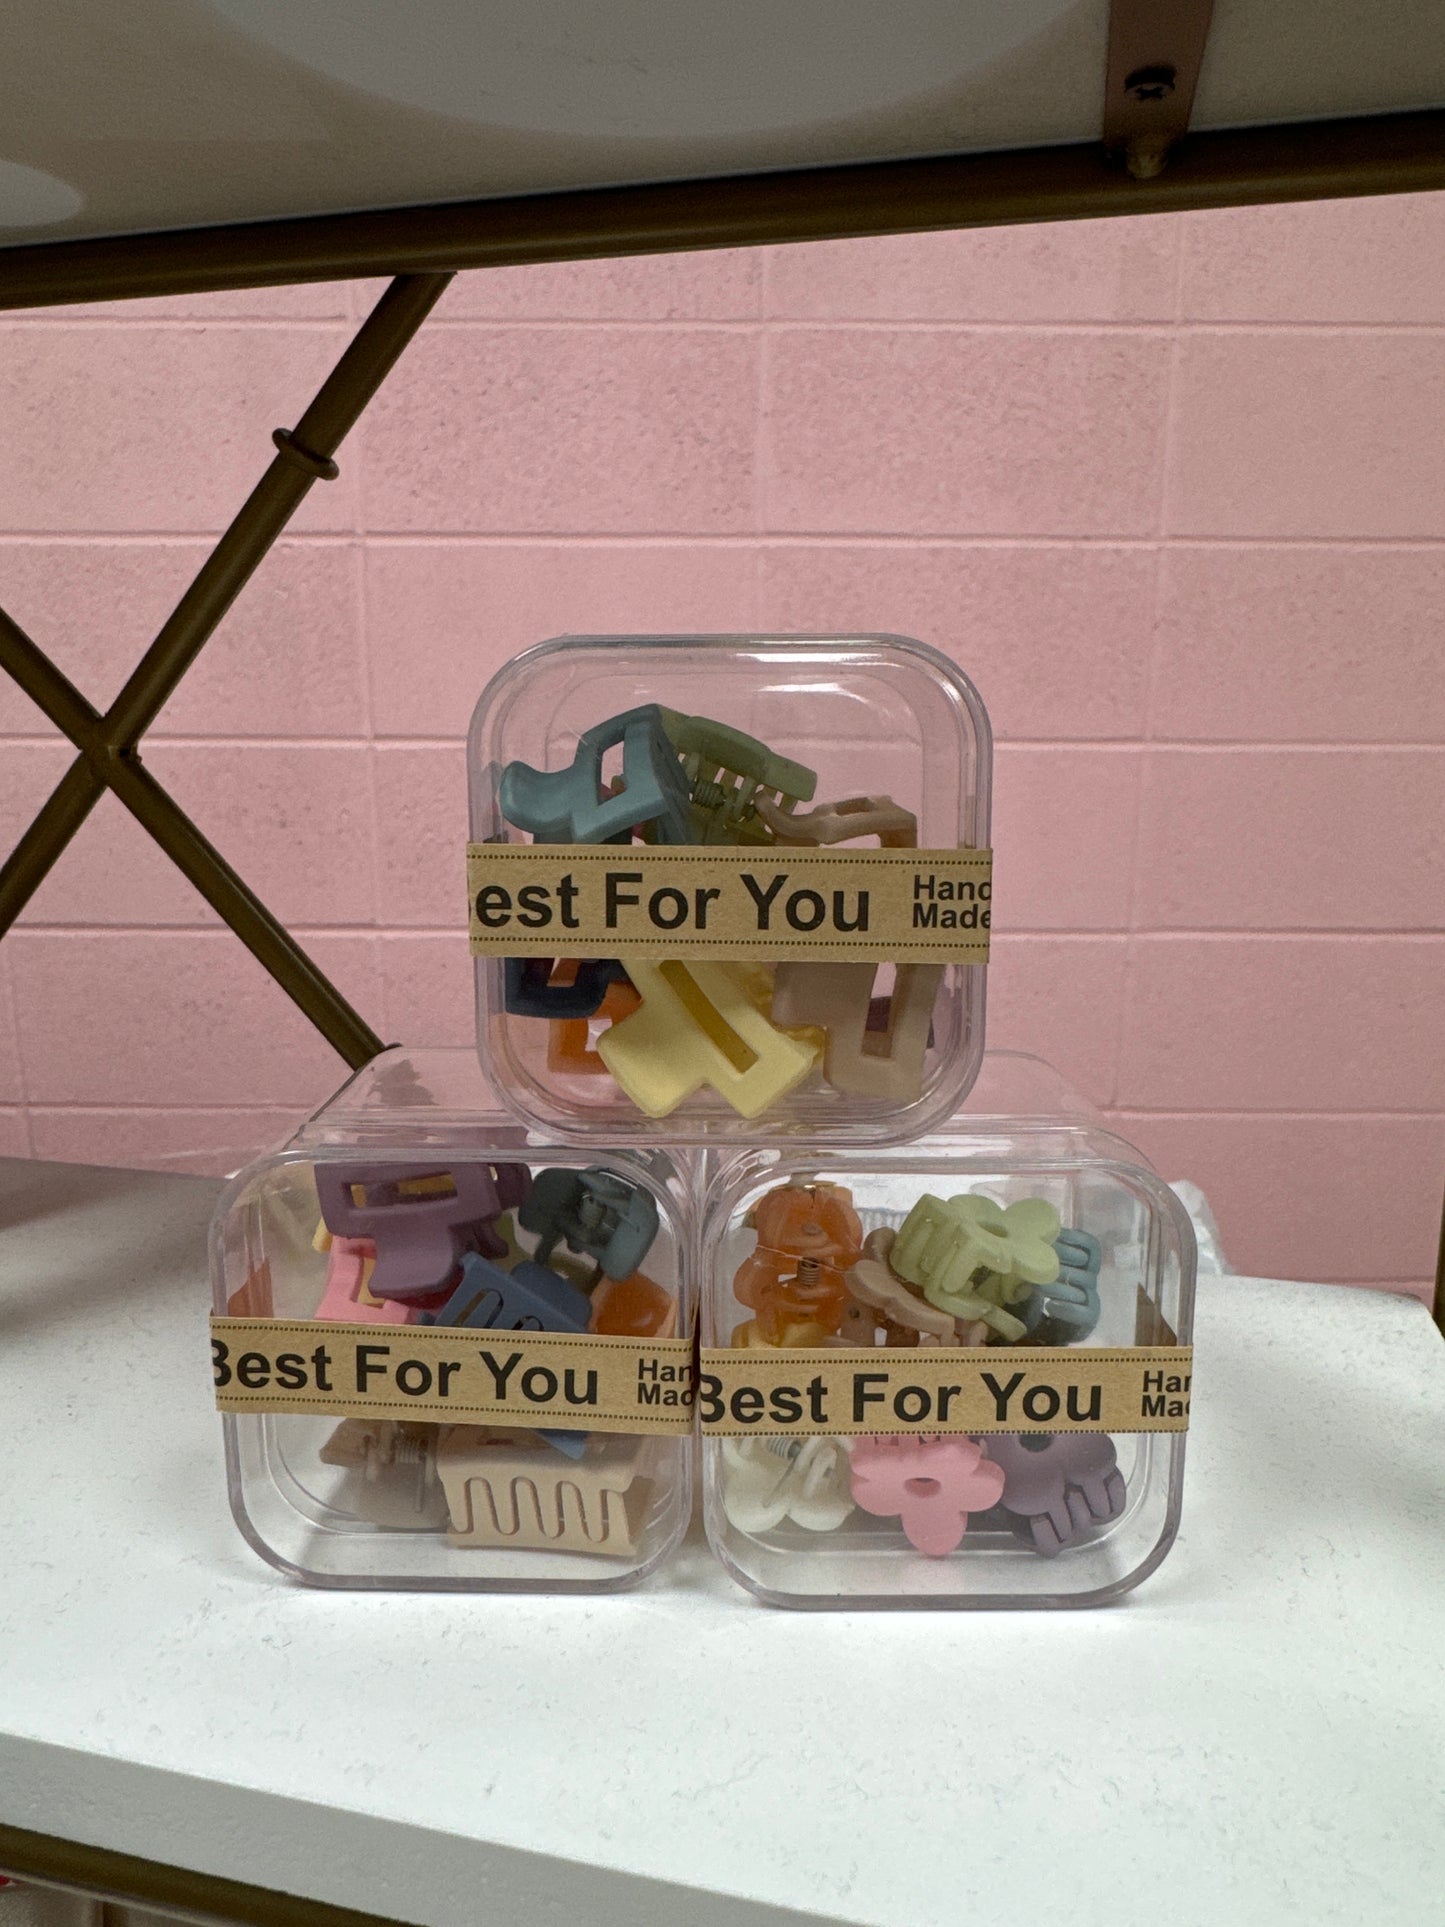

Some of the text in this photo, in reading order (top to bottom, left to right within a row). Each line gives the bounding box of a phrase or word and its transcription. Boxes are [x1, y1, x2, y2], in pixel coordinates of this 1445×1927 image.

[472, 872, 870, 933] est For You
[211, 1338, 598, 1405] Best For You
[700, 1372, 1102, 1424] Best For You
